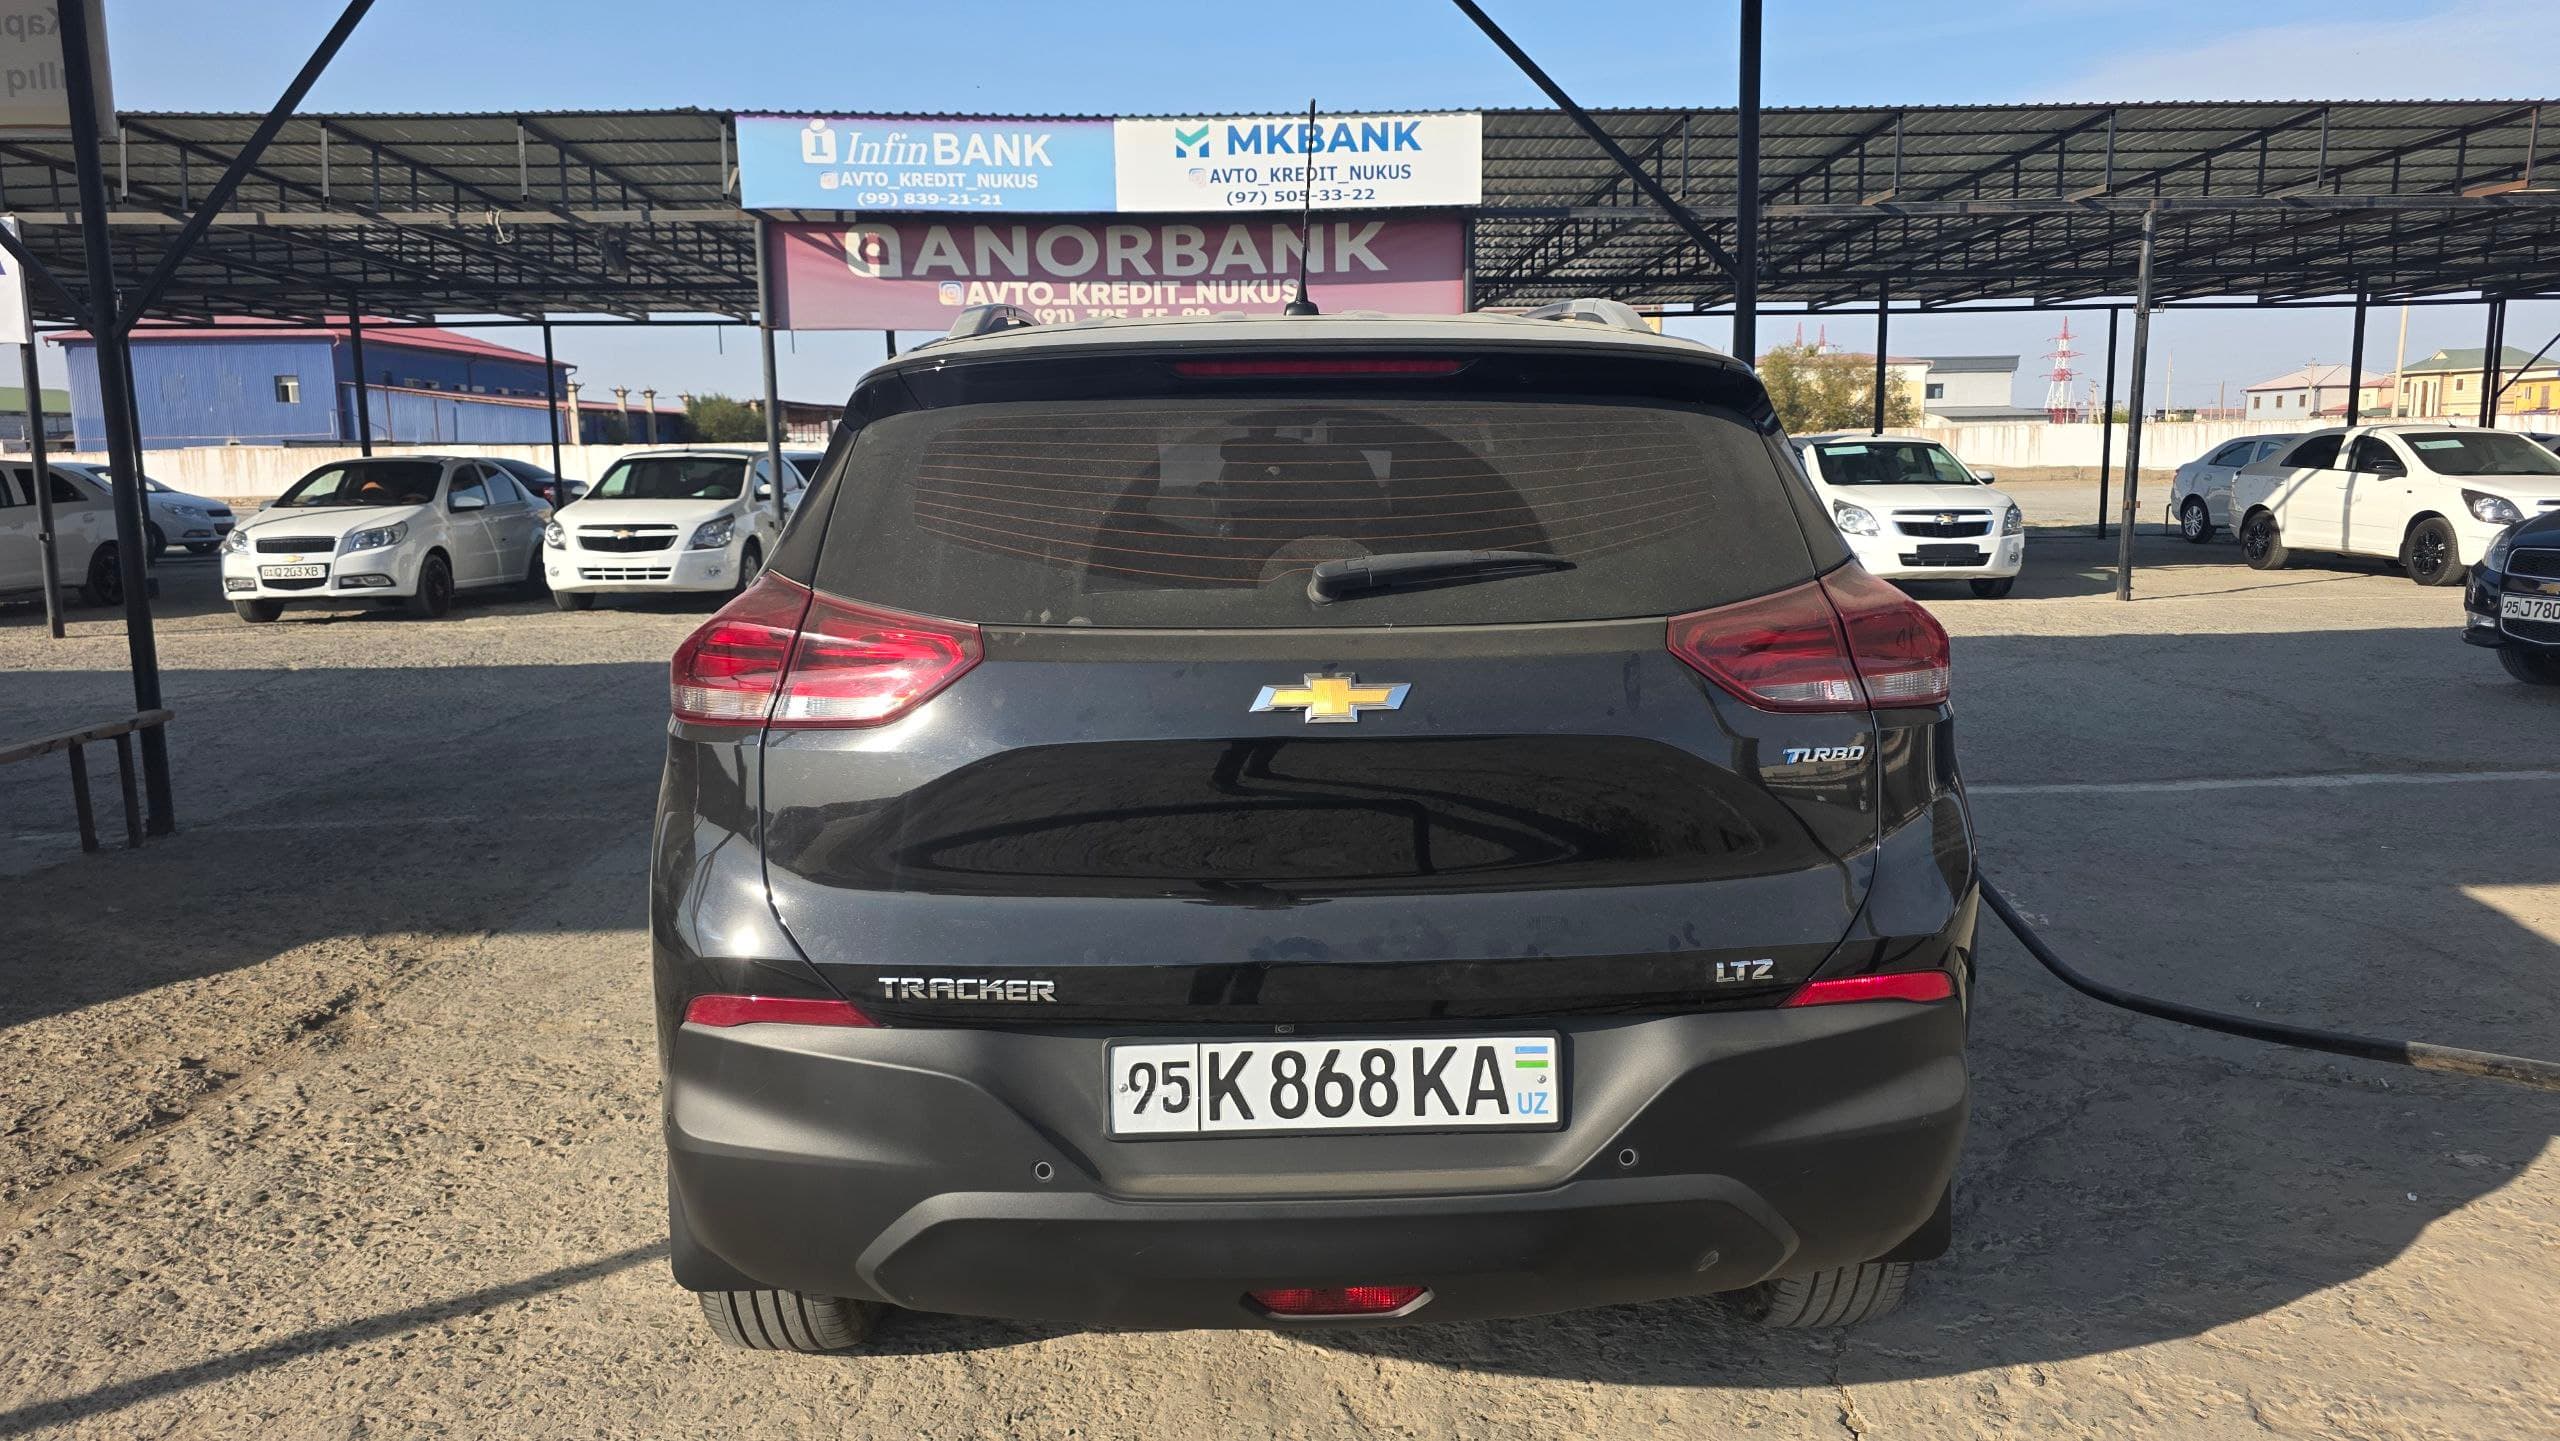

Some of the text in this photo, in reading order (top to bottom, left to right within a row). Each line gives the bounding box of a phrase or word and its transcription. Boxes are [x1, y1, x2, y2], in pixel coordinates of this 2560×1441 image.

[843, 131, 1053, 167] InfinBANK
[1227, 120, 1423, 155] MKBANK
[841, 171, 1039, 191] AVTO_KREDIT_NUKUS
[1209, 164, 1412, 186] AVTO_KREDIT_NUKUS
[857, 191, 1003, 207] (99) 839-21-21
[1226, 187, 1376, 206] (97) 505-33-22
[911, 221, 1389, 278] ANORBANK
[966, 279, 1300, 306] AVTO_KREDIT_NUKUS
[2504, 601, 2519, 614] 95
[1782, 745, 1865, 765] TURBO
[1715, 958, 1774, 983] LTZ
[878, 977, 1058, 1002] TRACKER
[1127, 1060, 1191, 1115] 95
[1516, 1091, 1550, 1115] UZ
